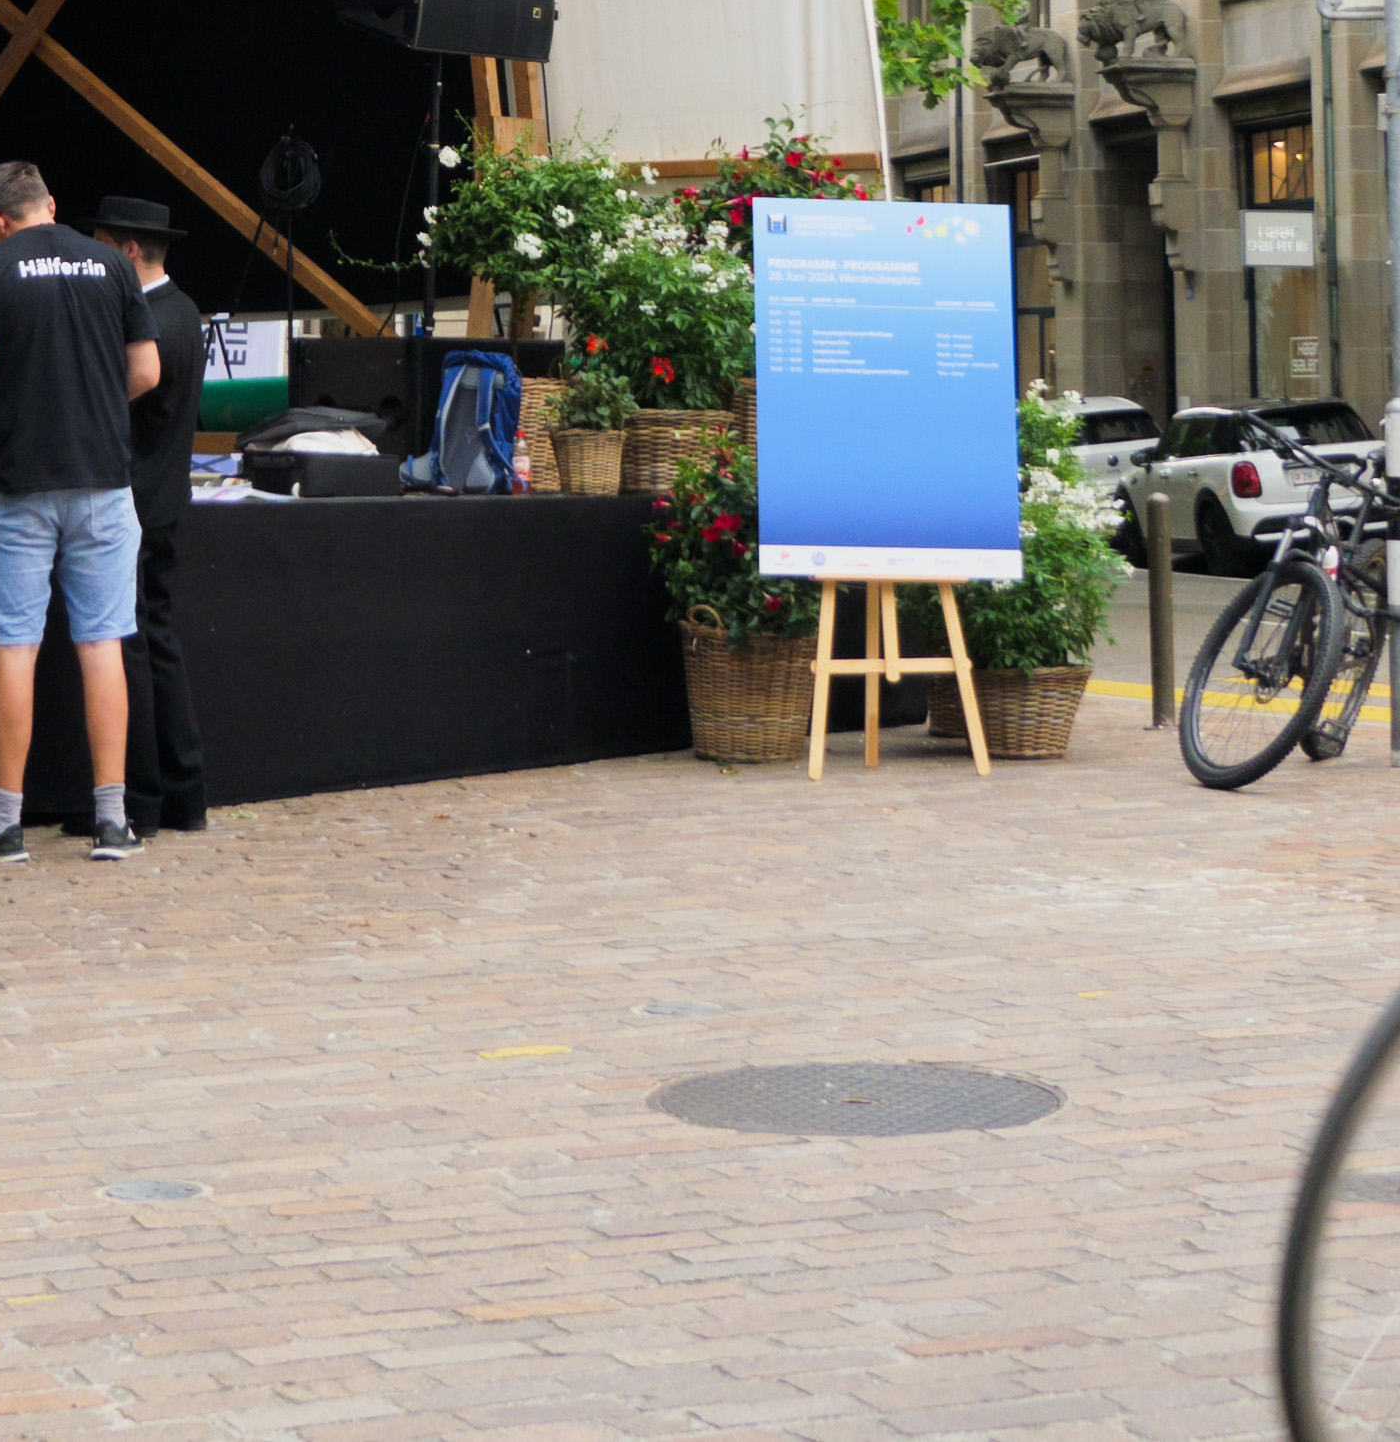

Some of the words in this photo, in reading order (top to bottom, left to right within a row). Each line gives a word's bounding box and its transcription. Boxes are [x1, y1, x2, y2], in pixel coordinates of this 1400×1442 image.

[18, 256, 107, 278] Hälfer:in
[767, 257, 837, 270] PROGRAMM
[843, 260, 919, 273] PROGRAMME
